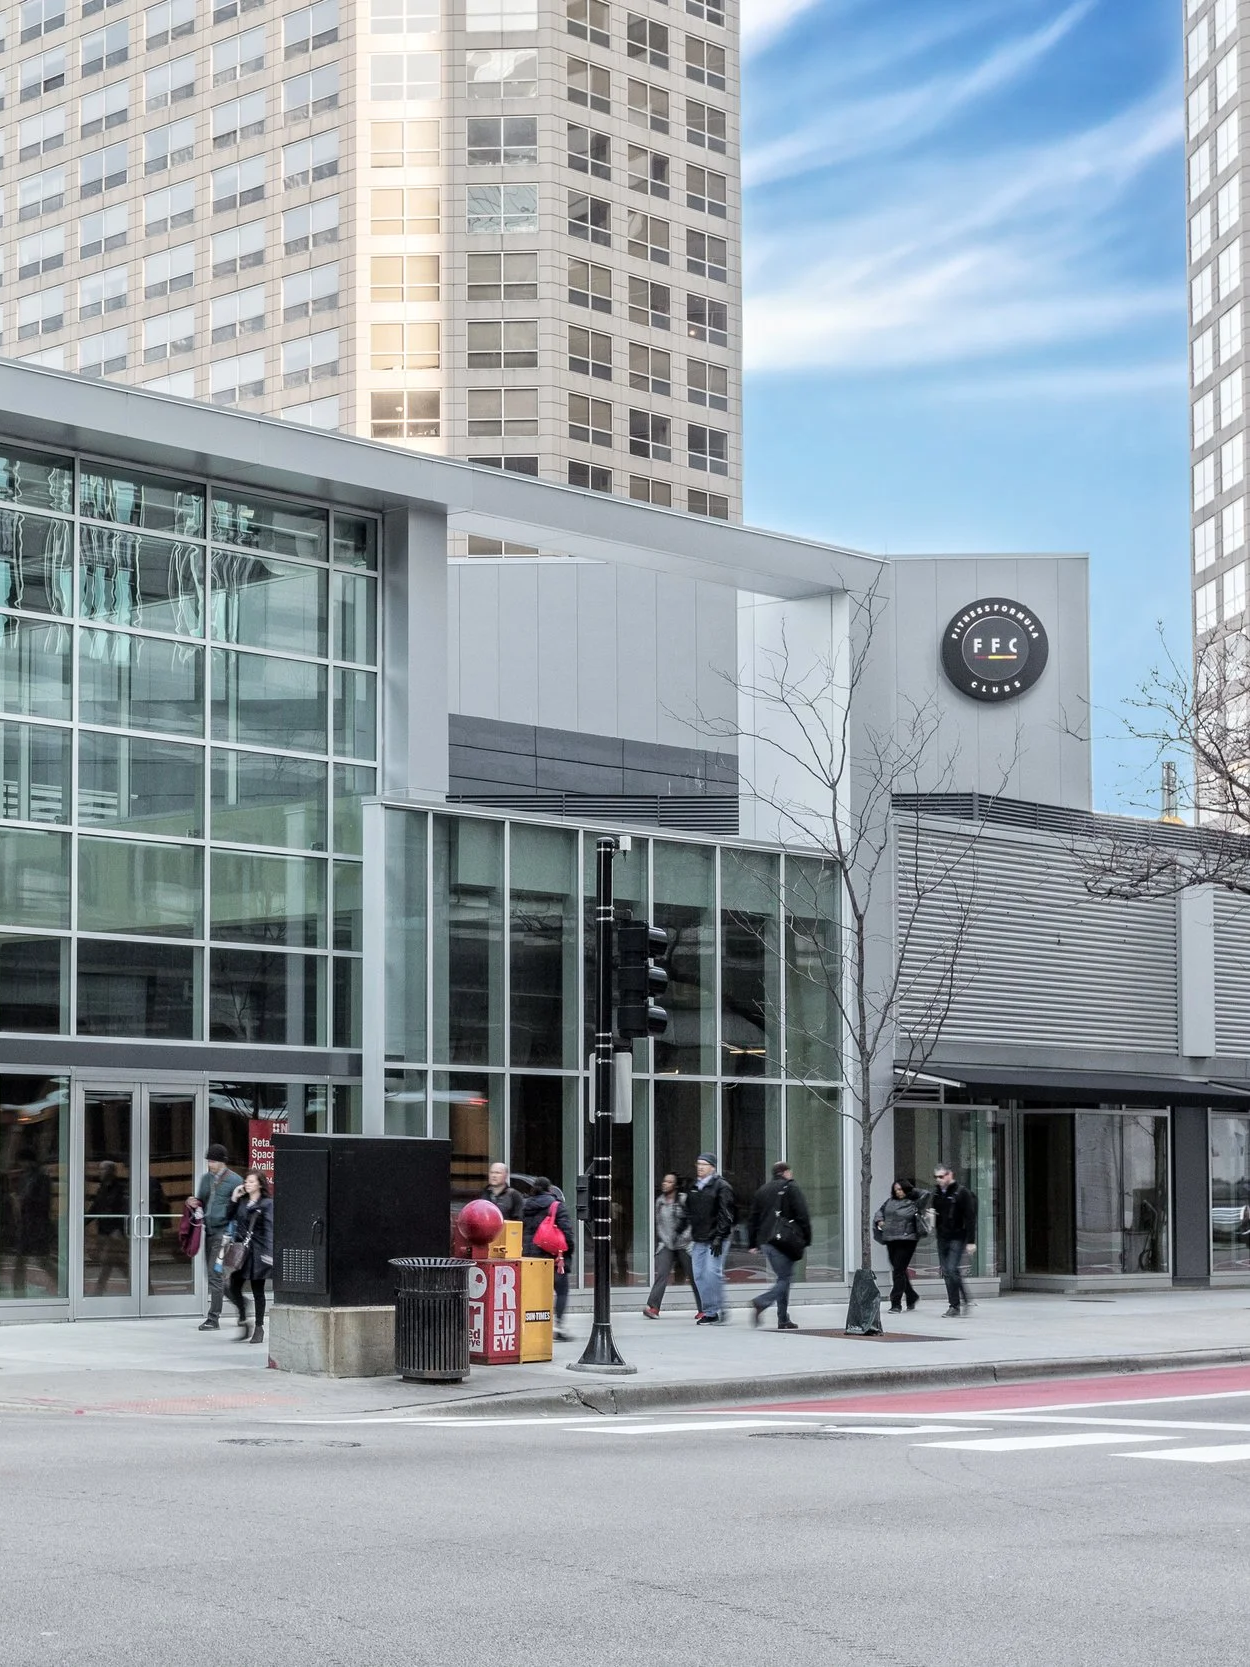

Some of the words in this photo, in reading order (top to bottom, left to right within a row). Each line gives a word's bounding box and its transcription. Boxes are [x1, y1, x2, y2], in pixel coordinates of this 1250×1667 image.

[952, 605, 991, 639] FITNESS
[993, 604, 1039, 639] FORMULA
[973, 637, 1017, 653] FFC
[971, 680, 1021, 693] CLUBS
[251, 1137, 274, 1147] Reta
[493, 1310, 516, 1335] ED
[493, 1335, 515, 1351] EYE
